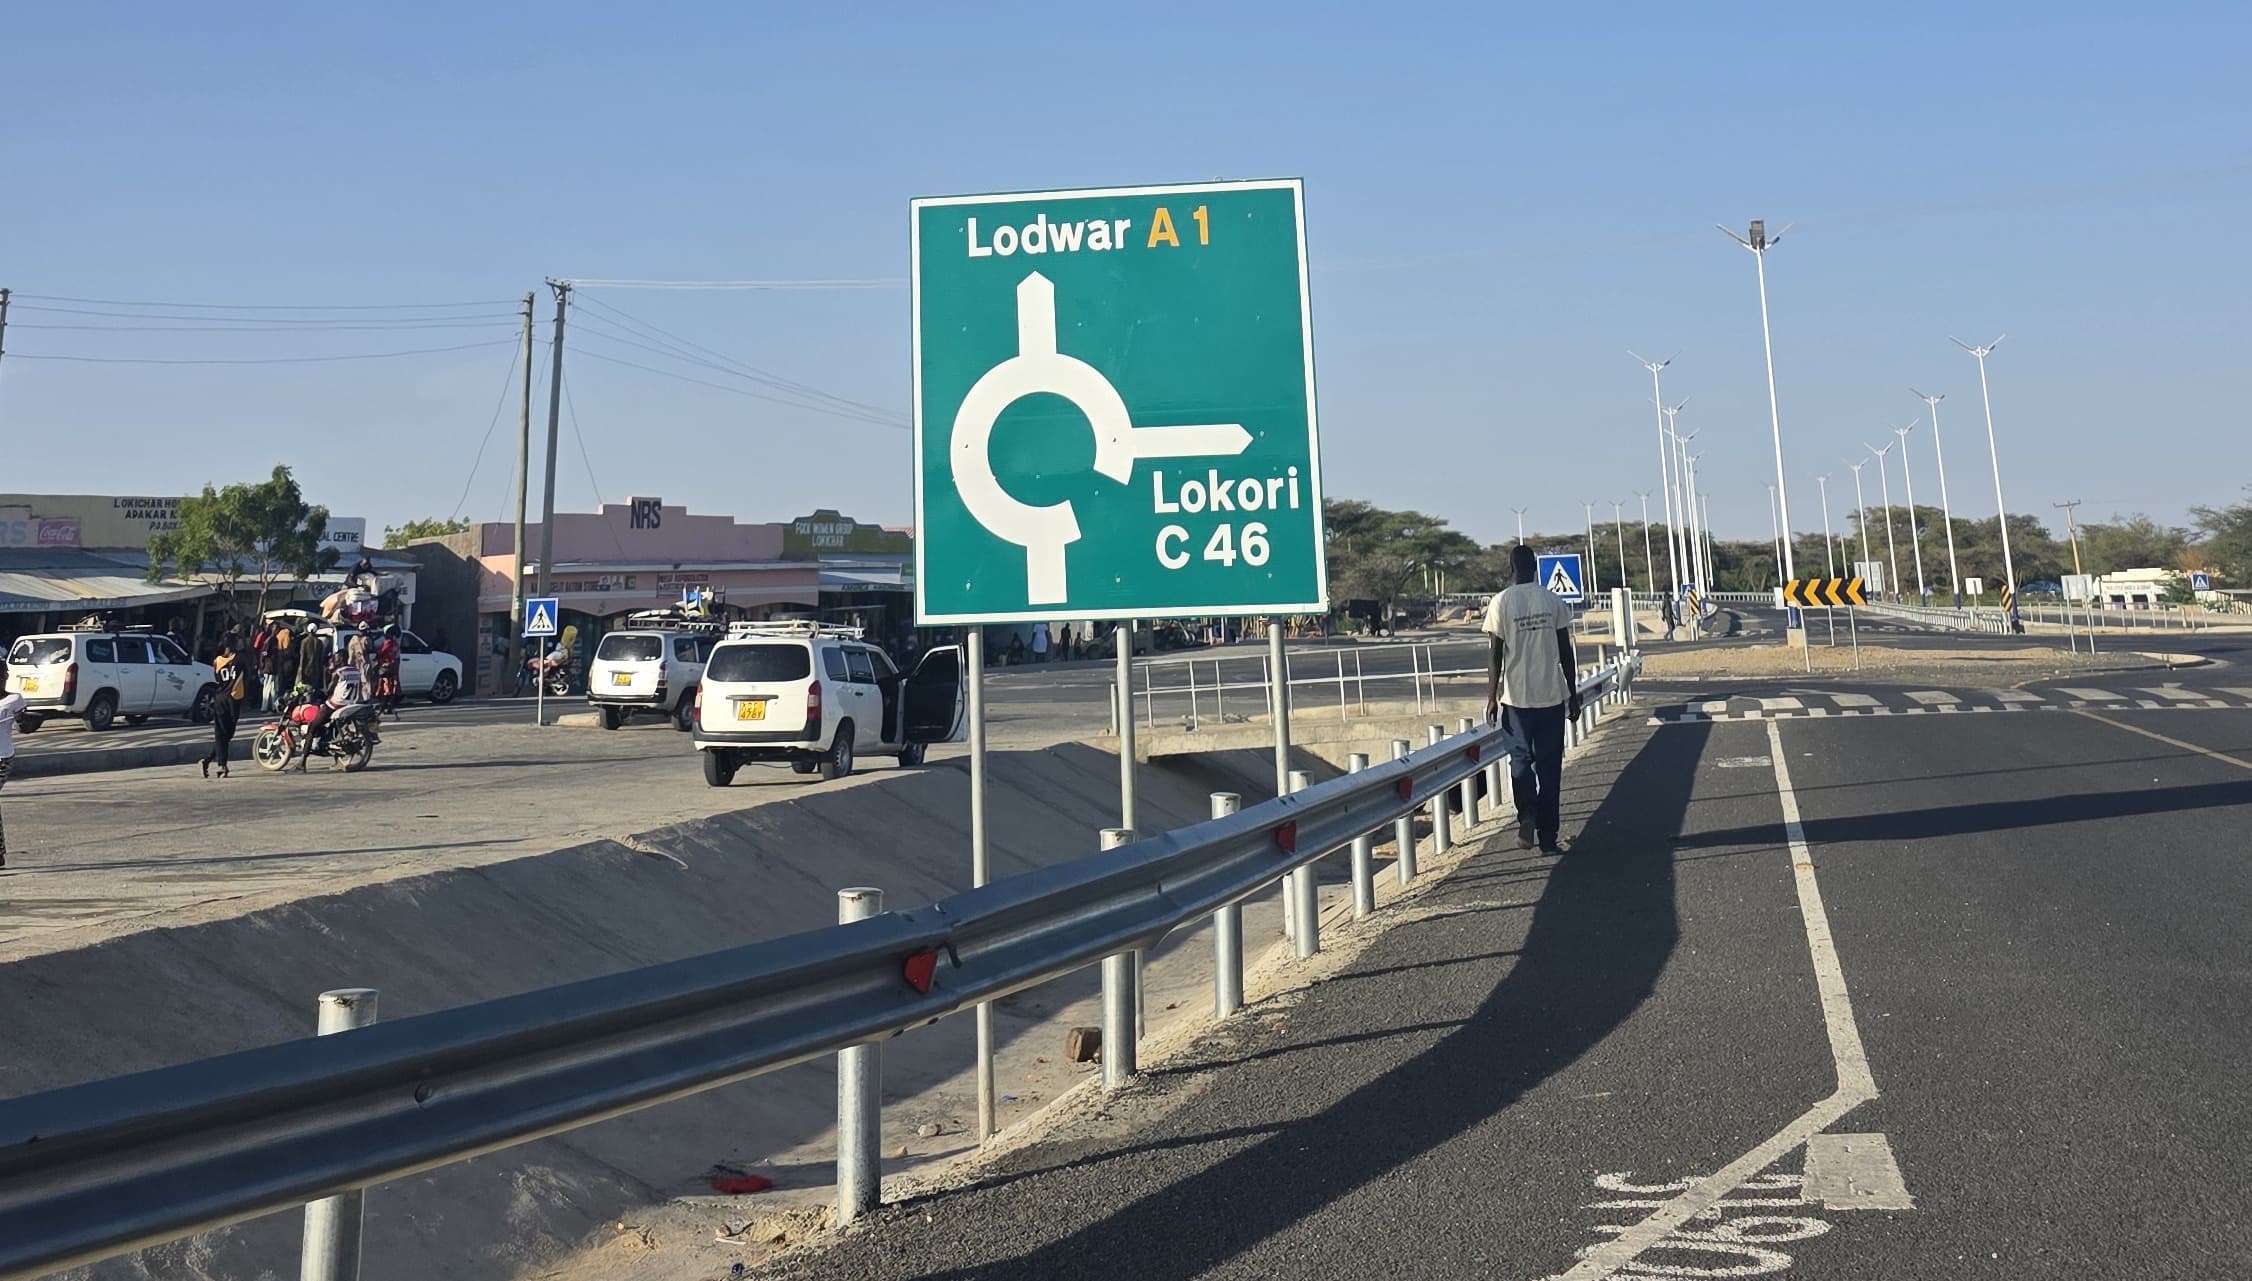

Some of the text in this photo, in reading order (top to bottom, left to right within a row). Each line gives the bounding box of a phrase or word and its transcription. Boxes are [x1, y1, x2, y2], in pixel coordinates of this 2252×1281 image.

[968, 205, 1209, 257] Lodwar A 1
[1153, 466, 1300, 514] Lokori
[630, 500, 661, 529] NRS
[1156, 522, 1271, 570] C 46
